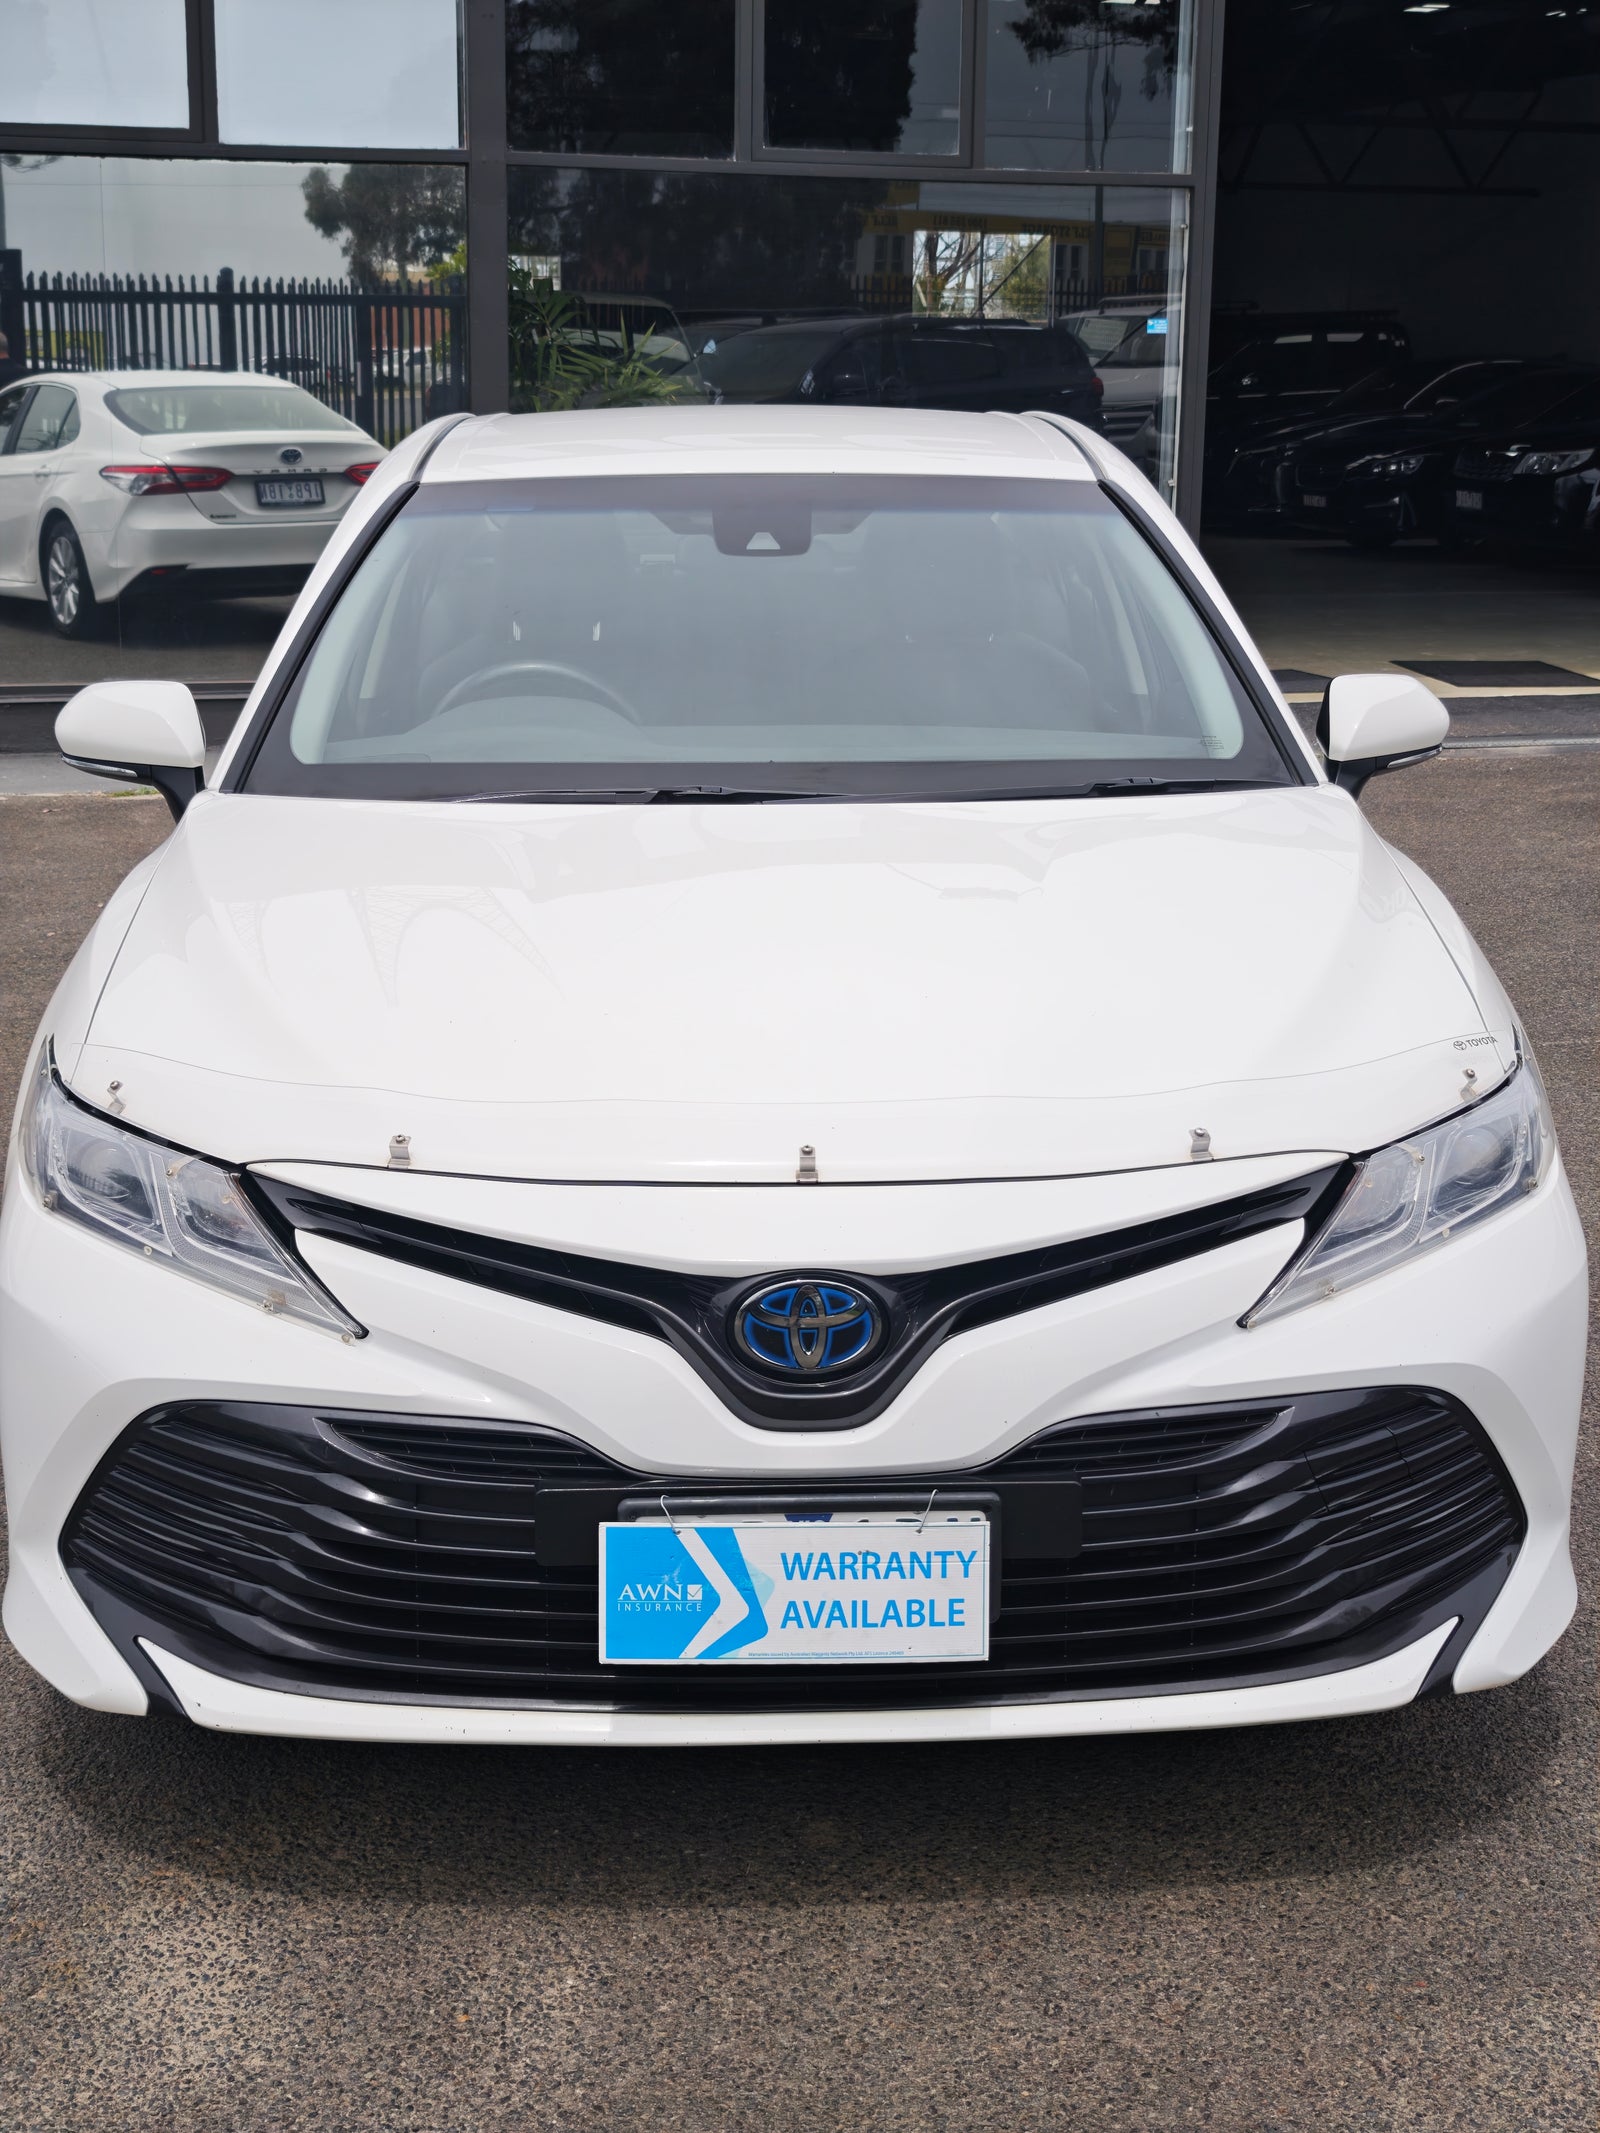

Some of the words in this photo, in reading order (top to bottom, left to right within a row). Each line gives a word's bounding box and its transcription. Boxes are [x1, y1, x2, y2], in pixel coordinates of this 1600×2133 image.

[1466, 1036, 1498, 1047] TOYOTA
[780, 1550, 978, 1580] WARRANTY
[617, 1583, 683, 1601] AWN
[617, 1603, 702, 1612] INSURANCE
[780, 1598, 966, 1629] AVAILABLE
